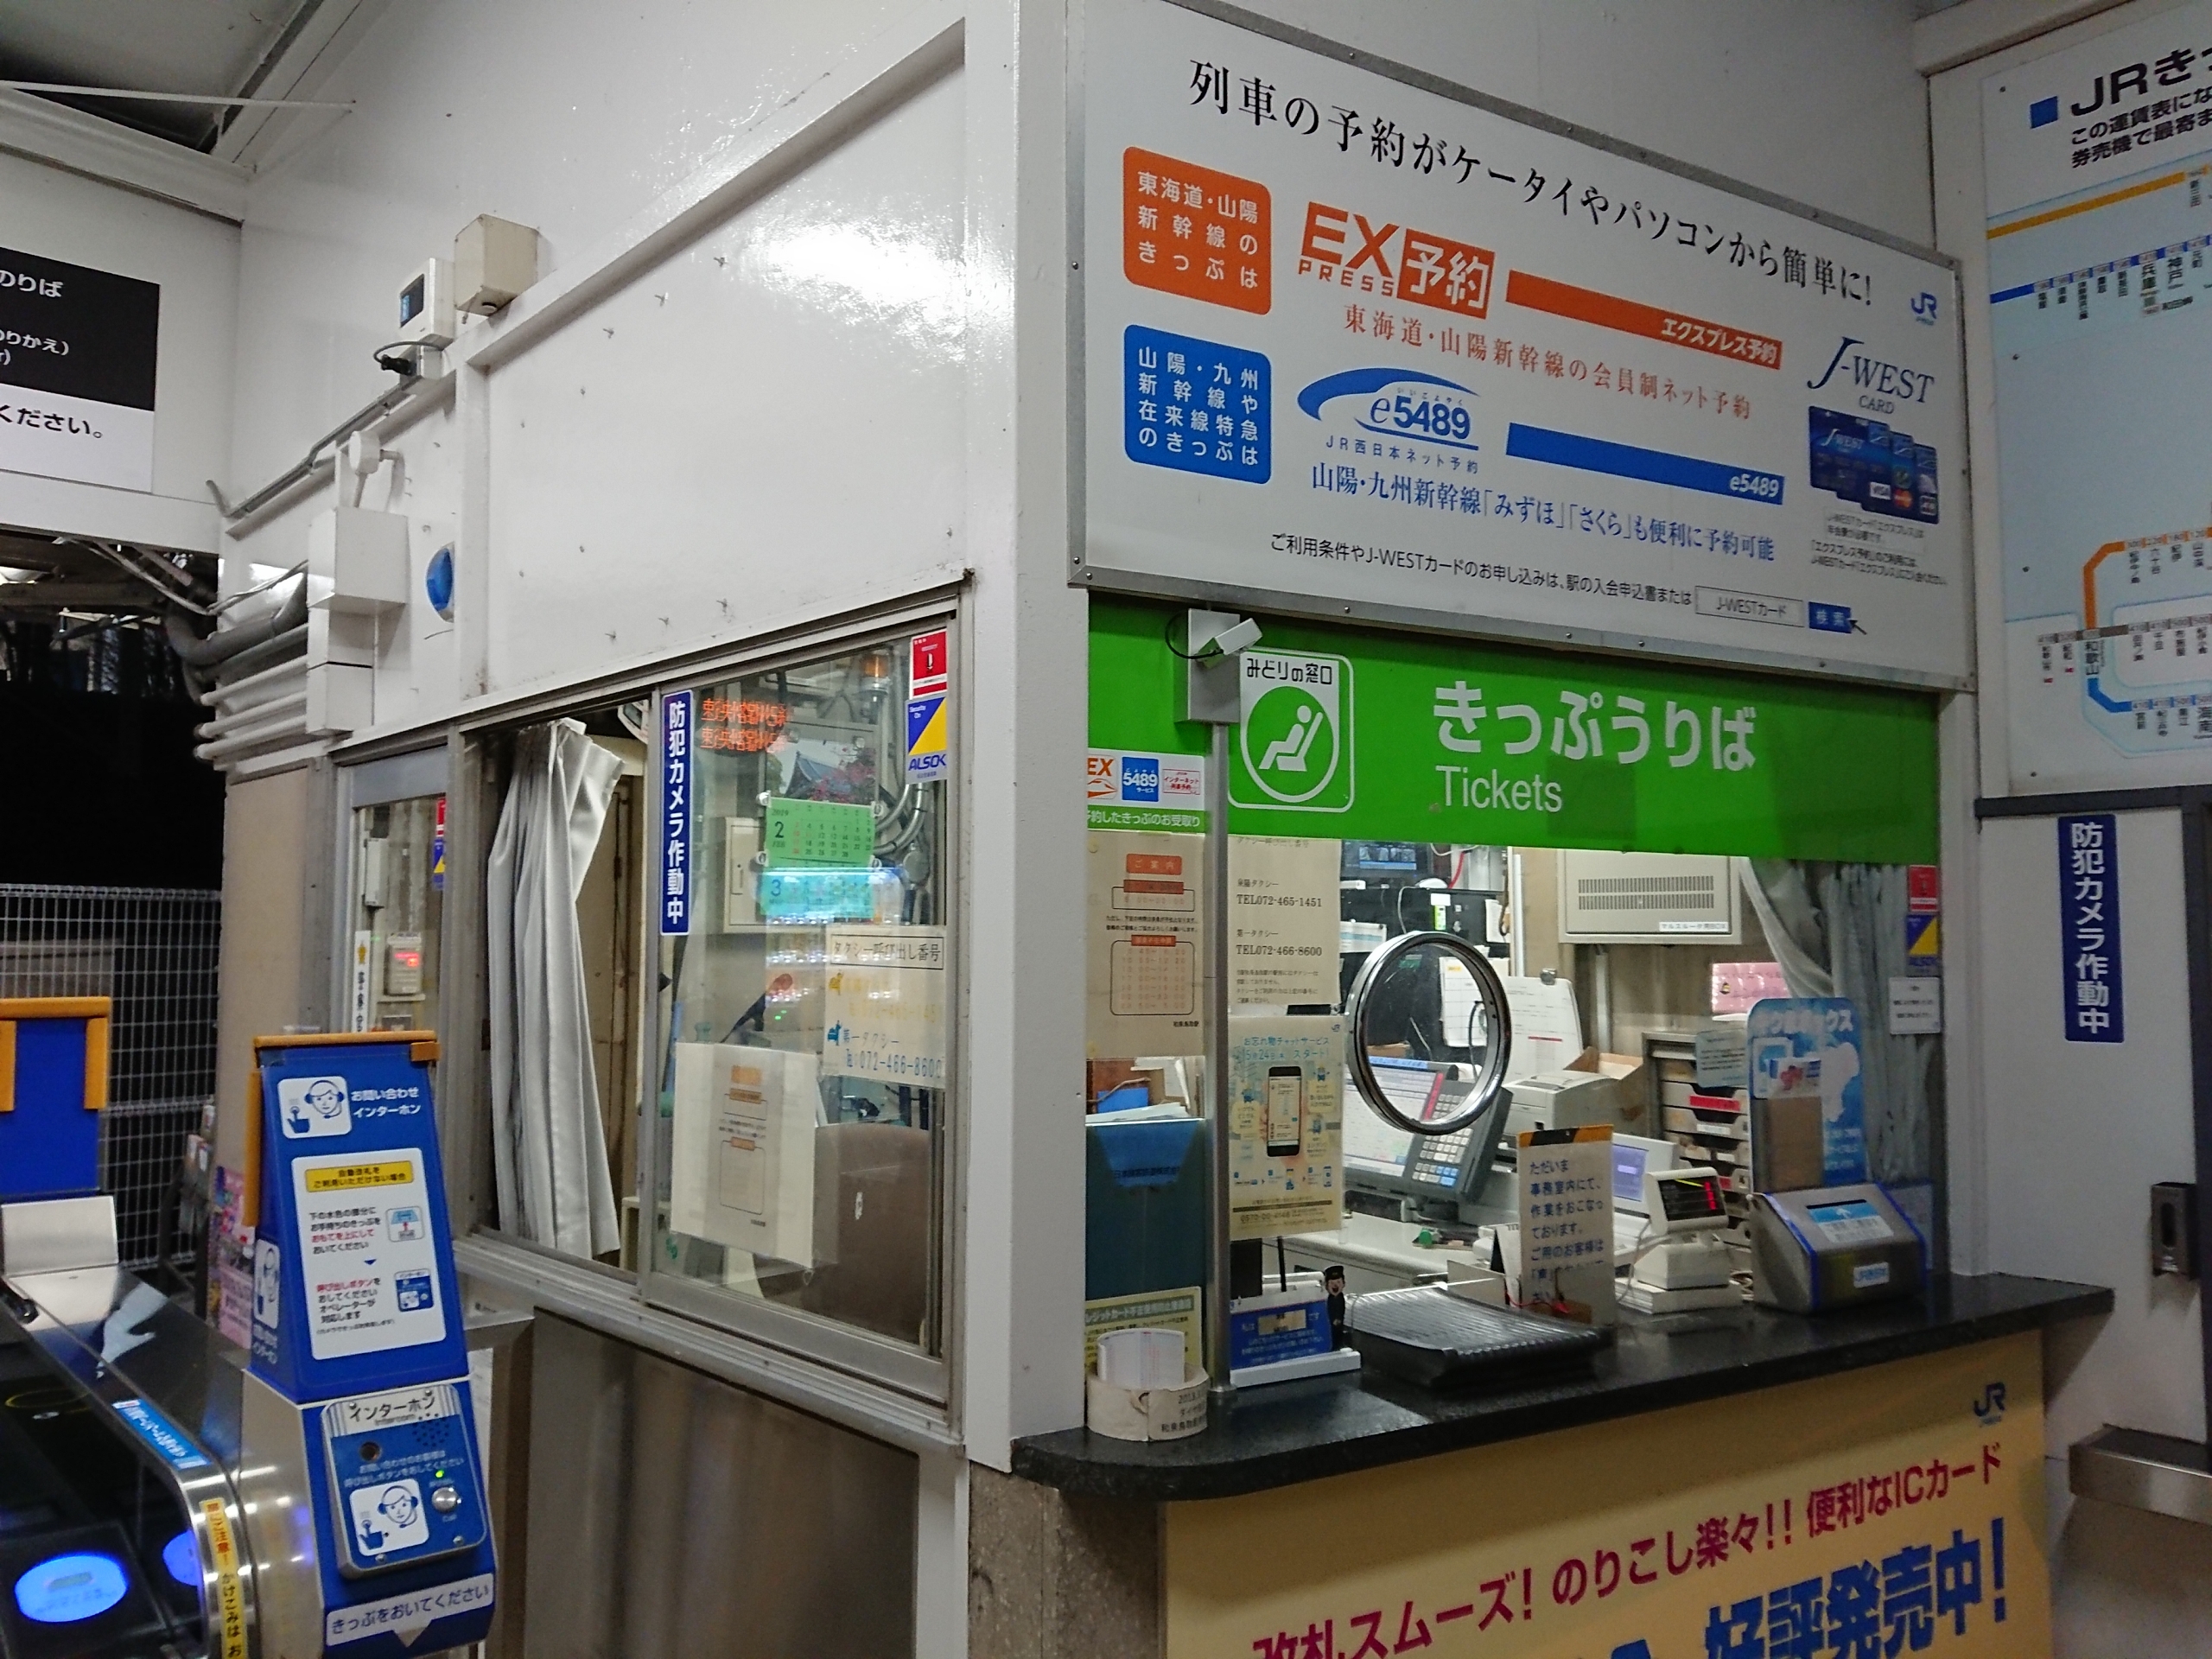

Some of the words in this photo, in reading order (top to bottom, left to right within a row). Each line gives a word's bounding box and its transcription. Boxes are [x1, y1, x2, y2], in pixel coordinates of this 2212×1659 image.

[1138, 171, 1258, 225] 東海道・山陽
[1138, 205, 1258, 255] 新幹線の
[1138, 240, 1258, 289] きっぷは
[1298, 261, 1395, 297] PRESS
[1407, 240, 1491, 311] 予約
[1344, 304, 1751, 420] 東海道・山陽新幹線の会員制ネット予約
[1662, 317, 1780, 365] エクスプレス予約
[1138, 346, 1258, 390] 山陽・九州
[1807, 336, 1935, 404] J-WEST
[1138, 372, 1258, 414] 新幹線や
[1859, 395, 1895, 415] CARD
[1138, 398, 1258, 442] 在来線特急
[1370, 395, 1471, 440] e5489
[1138, 426, 1258, 466] のきっぷは
[1325, 435, 1478, 474] JR西日本ネット予約
[1729, 474, 1780, 499] e5489
[1312, 462, 1776, 562] 山陽・九州新幹線「みずほ」「さくら」も便利に予約可能
[1270, 532, 1693, 605] ご利用条件やJ-WESTカードのお申し込みは、駅の入会申込書または
[1246, 658, 1332, 685] みどりの窓口
[1433, 680, 1757, 772] きっぷうりば
[908, 753, 947, 772] ALSOK
[1087, 758, 1114, 777] EX
[1122, 772, 1159, 787] 5489
[1435, 765, 1563, 813] Tickets
[666, 702, 687, 925] 防犯カメラ作動中
[774, 821, 785, 838] 2
[1088, 810, 1201, 827] 約したきっぷのお受取り
[771, 879, 782, 897] 3
[2071, 823, 2110, 1034] 防犯カメラ作動中
[350, 1086, 421, 1103] お問い合わせ
[353, 1103, 422, 1118] インターホン
[349, 1395, 435, 1421] インターホン
[1806, 1441, 2002, 1538] 便利なICカード
[331, 1584, 490, 1635] きっぷをおいてください
[1703, 1516, 2007, 1659] 好評発売中!
